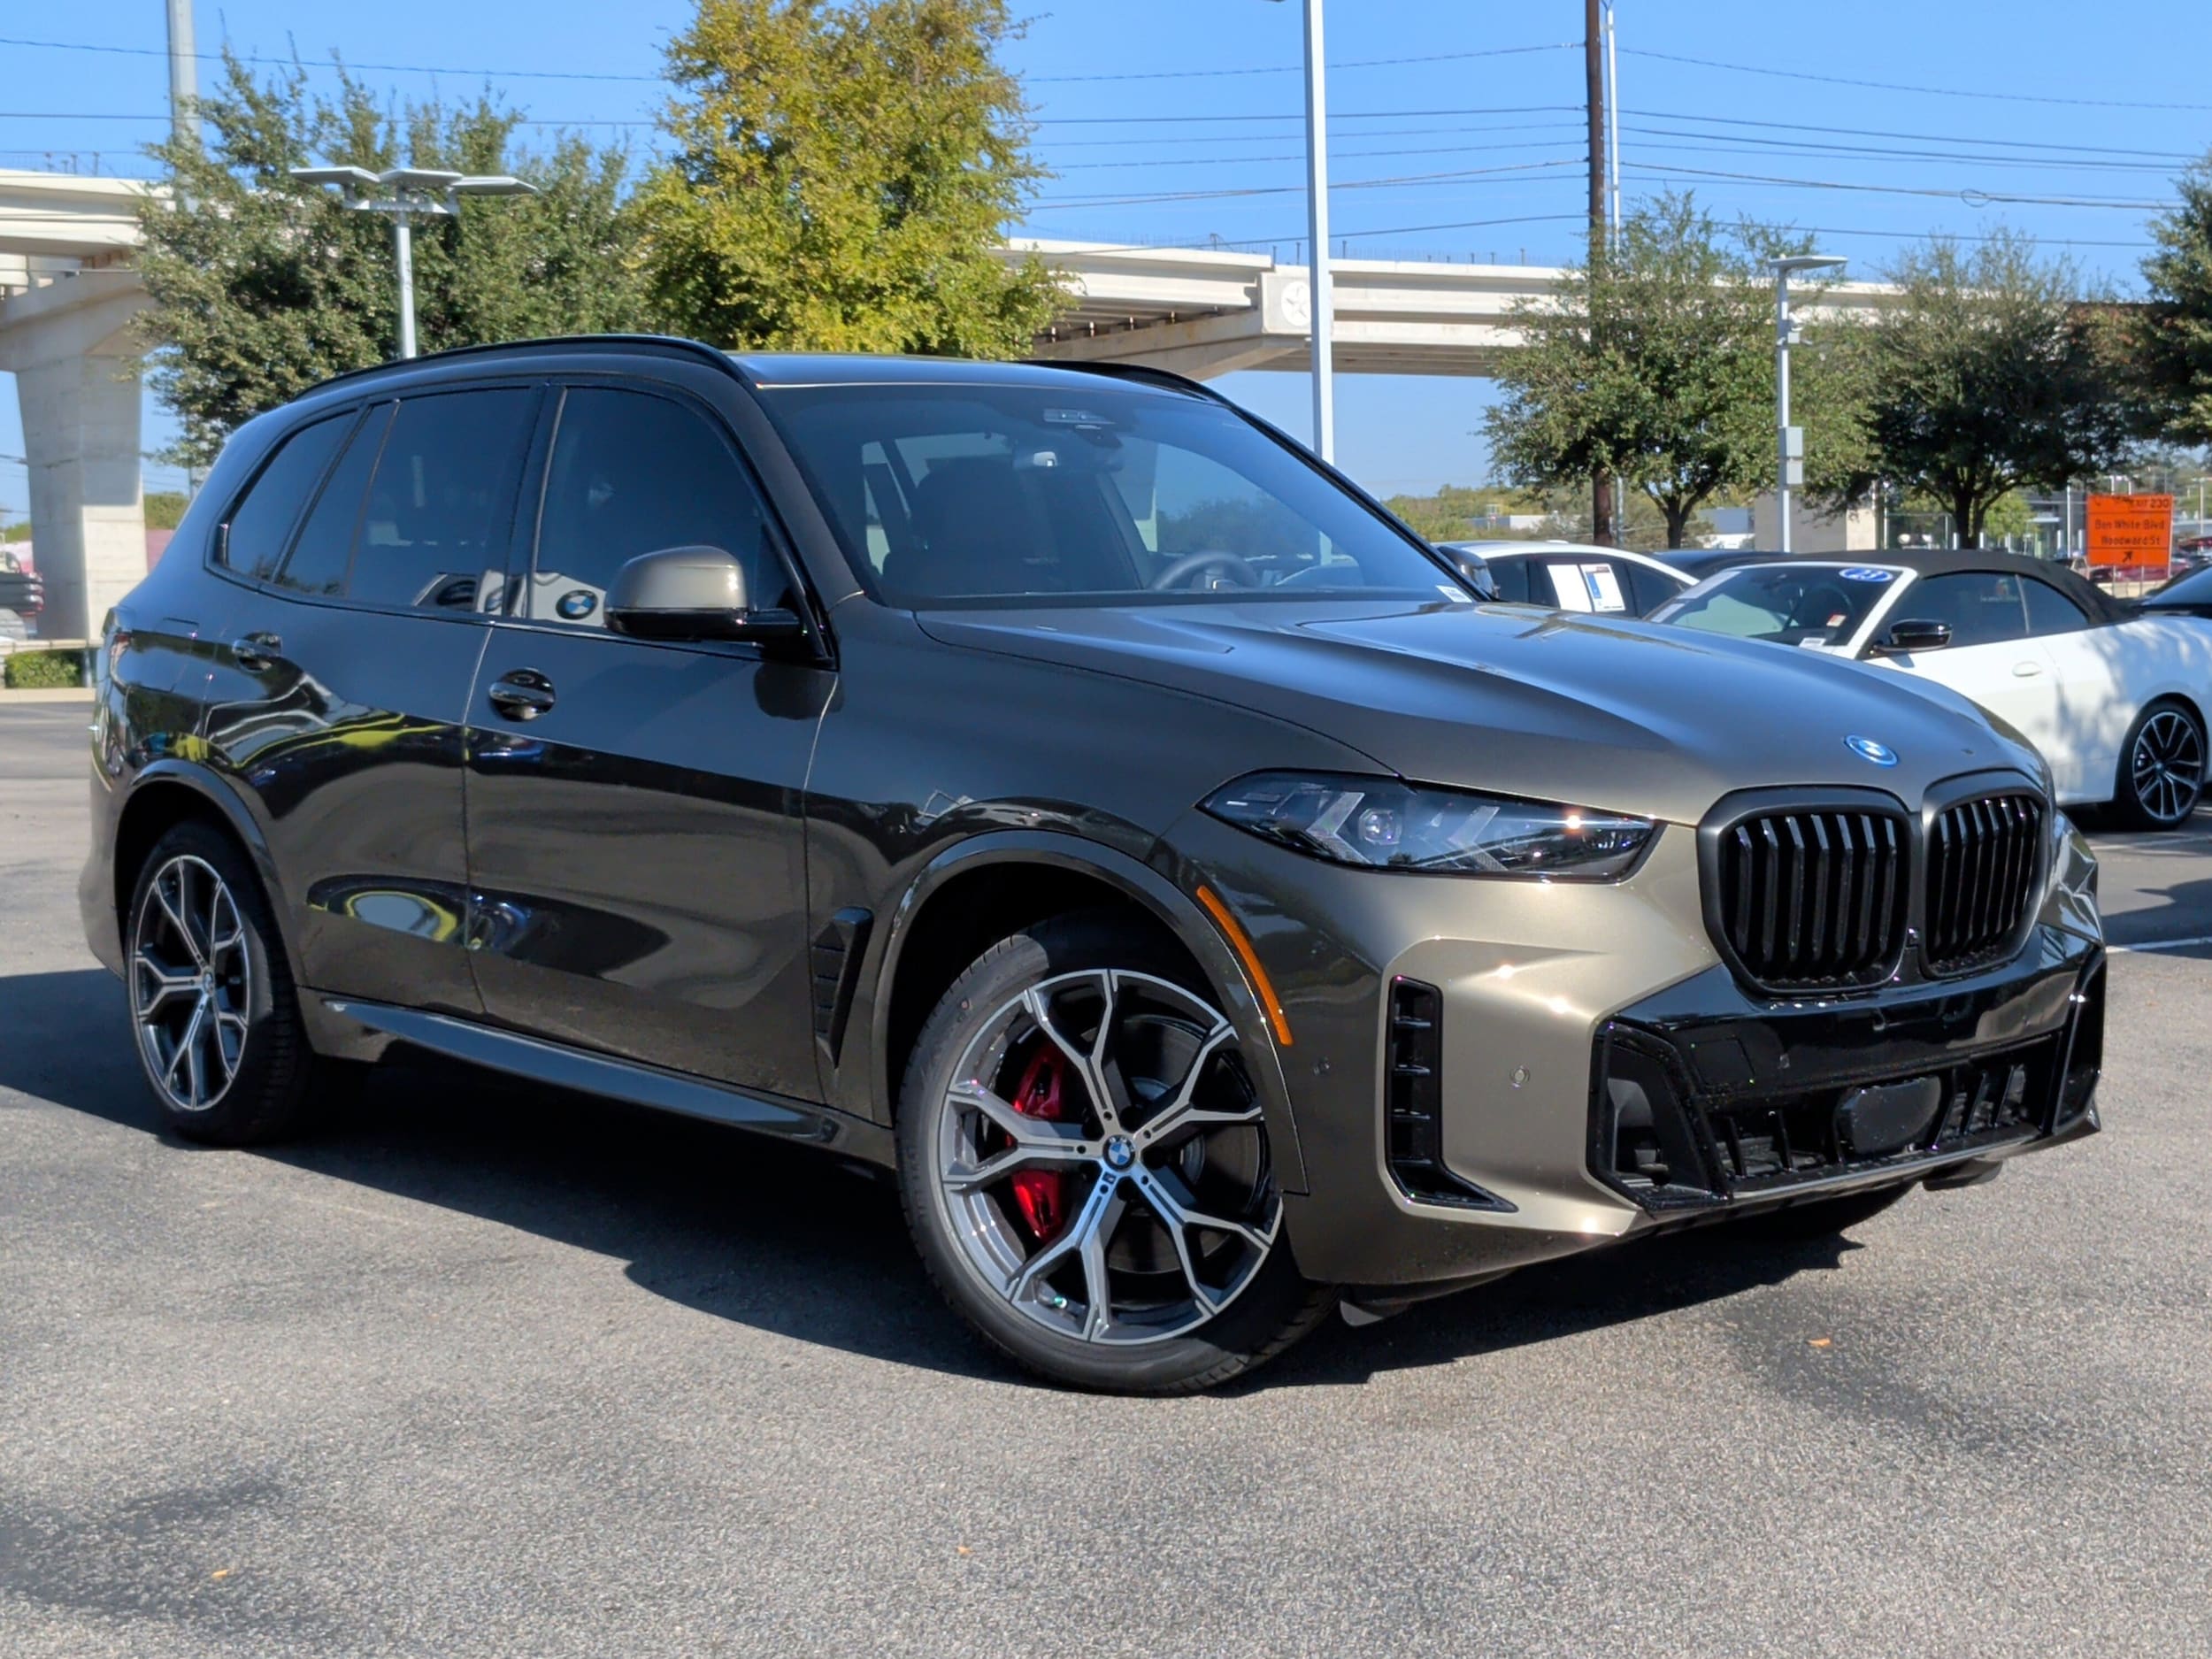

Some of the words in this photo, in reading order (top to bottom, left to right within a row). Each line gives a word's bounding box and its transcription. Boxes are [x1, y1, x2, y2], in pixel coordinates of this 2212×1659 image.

[2150, 498, 2170, 508] 230
[2114, 519, 2140, 529] White
[2143, 518, 2165, 529] Blvd
